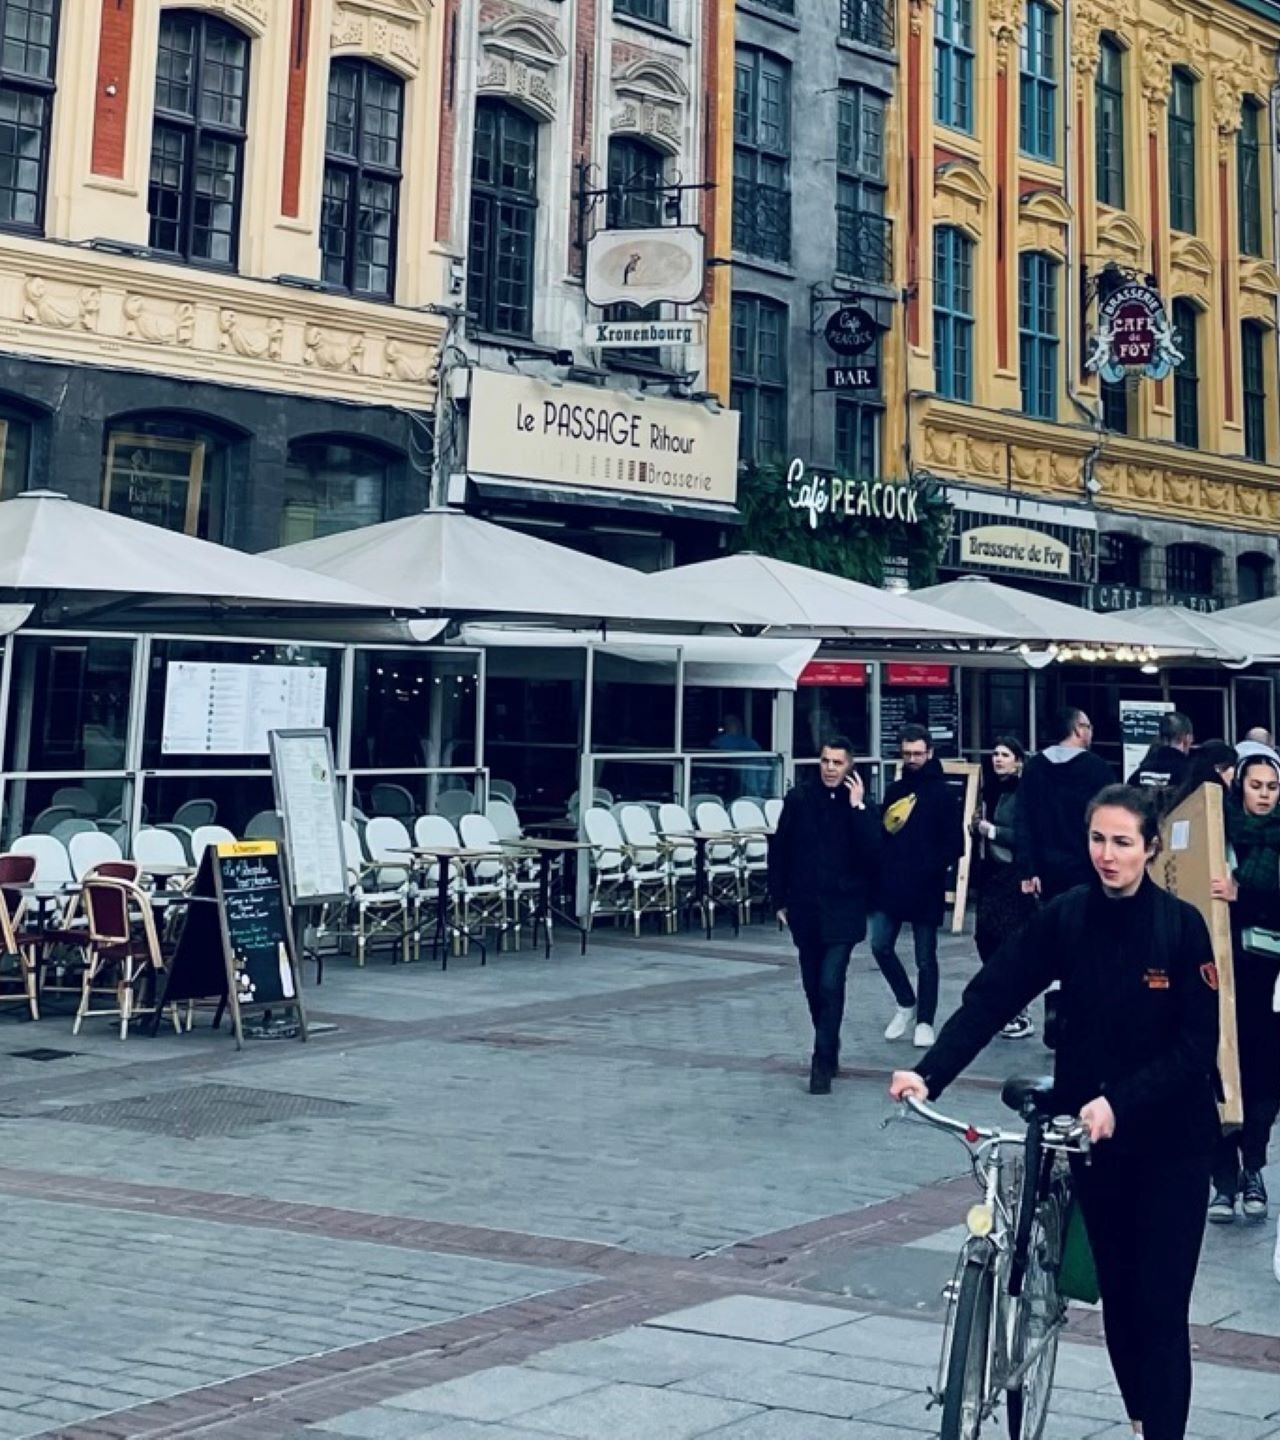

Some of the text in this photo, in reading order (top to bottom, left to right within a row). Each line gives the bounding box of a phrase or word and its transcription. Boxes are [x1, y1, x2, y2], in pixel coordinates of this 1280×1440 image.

[1103, 288, 1160, 314] BRASSERIE
[596, 325, 693, 344] Kronenbourg
[1120, 343, 1151, 358] FOY
[833, 370, 871, 387] BAR
[517, 400, 696, 454] Le PASSAGE Rihour
[648, 462, 712, 491] Brasserie
[787, 458, 918, 529] Café PEACOCK
[969, 535, 1064, 569] Brasserie de Foy
